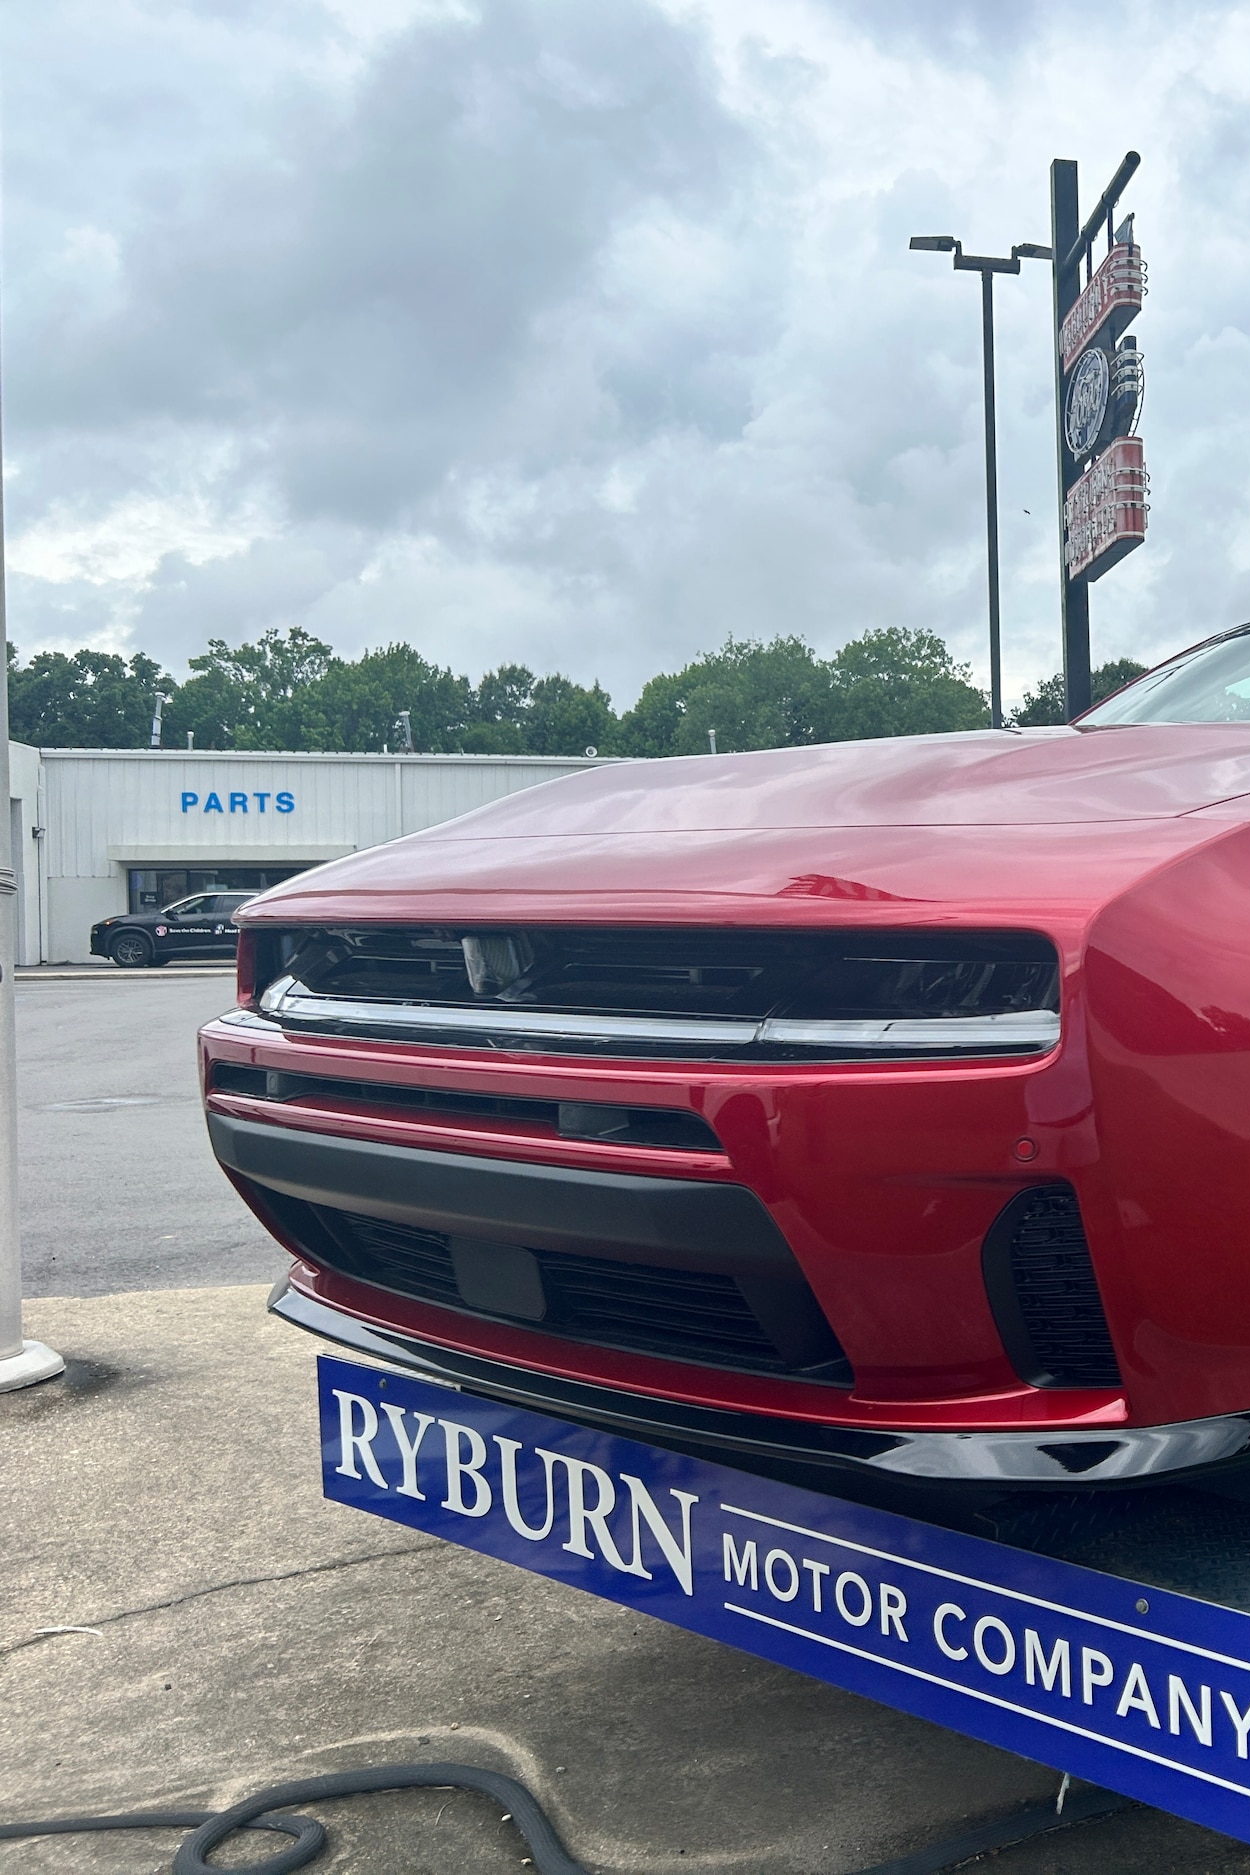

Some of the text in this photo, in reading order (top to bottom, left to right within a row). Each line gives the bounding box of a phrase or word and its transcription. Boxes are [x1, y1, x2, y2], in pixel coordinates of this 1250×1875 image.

[182, 792, 295, 813] PARTS
[331, 1387, 700, 1597] RYBURN
[722, 1532, 909, 1645] MOTOR
